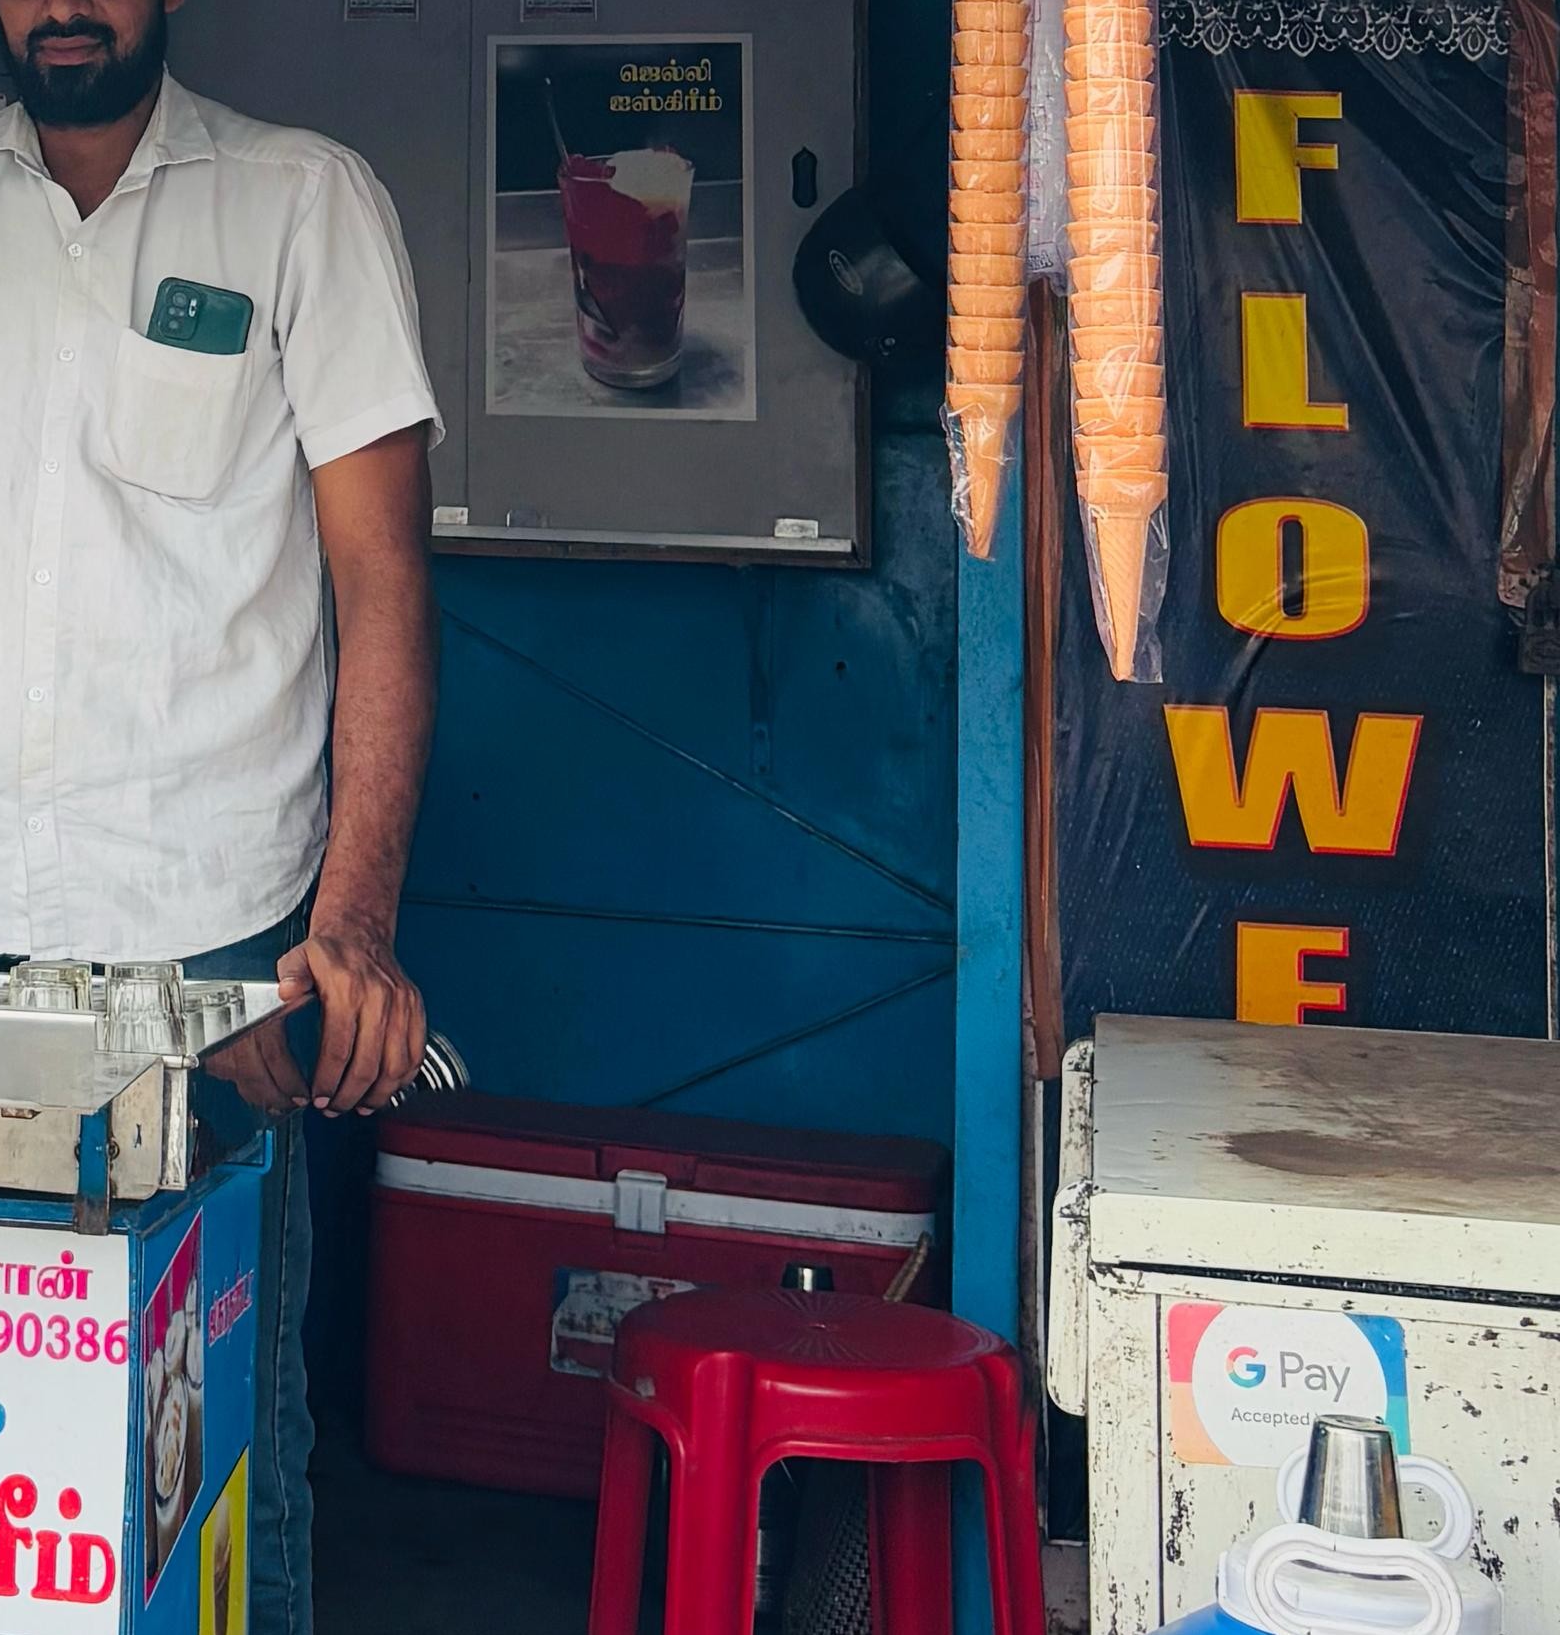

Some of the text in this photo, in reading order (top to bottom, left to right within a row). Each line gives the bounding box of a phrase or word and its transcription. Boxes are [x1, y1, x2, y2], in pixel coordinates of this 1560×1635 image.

[620, 58, 711, 82] ஜெல்லி
[610, 88, 723, 111] ஐஸ்கிரீம்
[1280, 1351, 1351, 1403] Pay
[1231, 1407, 1310, 1426] Accepted
